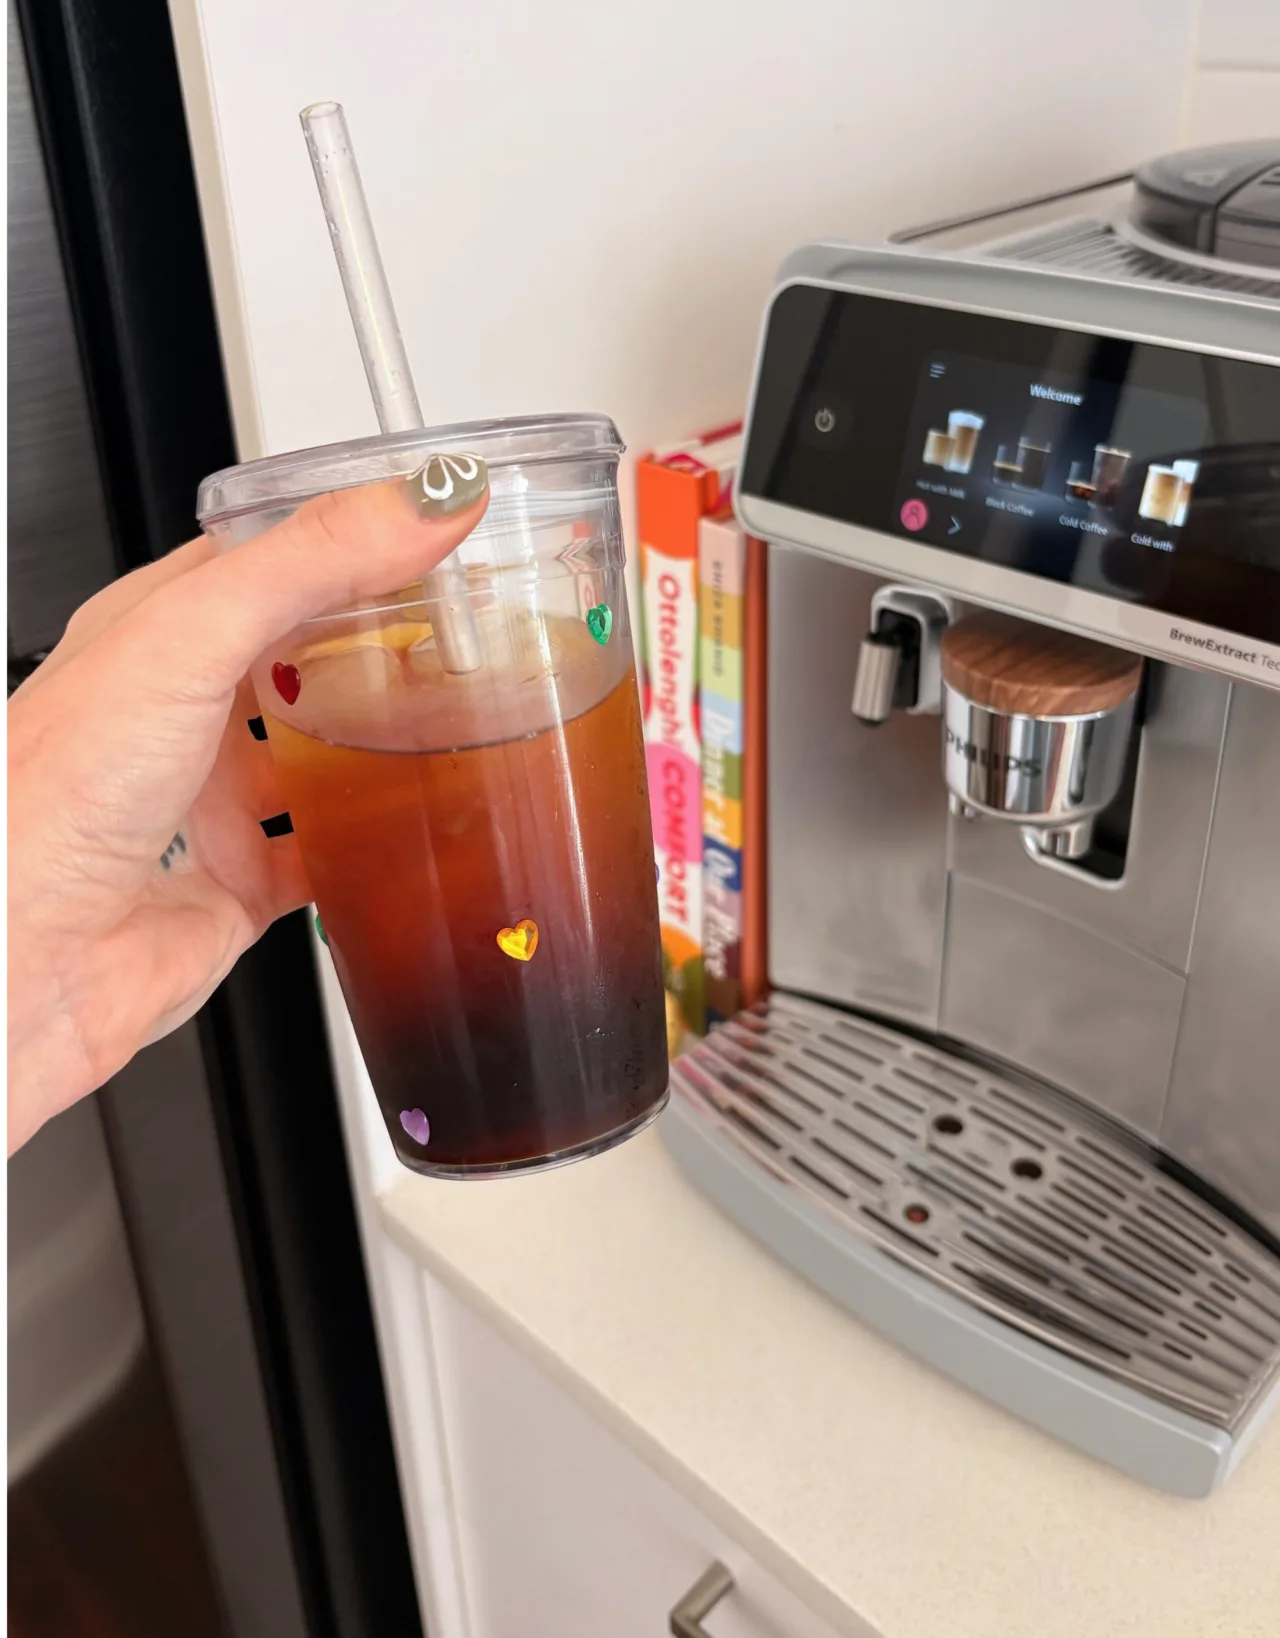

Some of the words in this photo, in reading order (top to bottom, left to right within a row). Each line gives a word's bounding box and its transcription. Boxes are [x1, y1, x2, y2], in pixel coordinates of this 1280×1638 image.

[1030, 383, 1082, 406] Welcome
[1007, 501, 1035, 518] Coffee
[1059, 514, 1079, 529] Cold
[1080, 518, 1109, 537] Coffee
[1131, 532, 1153, 547] Cold
[1153, 537, 1174, 551] with
[1169, 627, 1257, 664] BrewExtract
[655, 573, 686, 748] Ottolenghi
[662, 760, 689, 924] COMFORT
